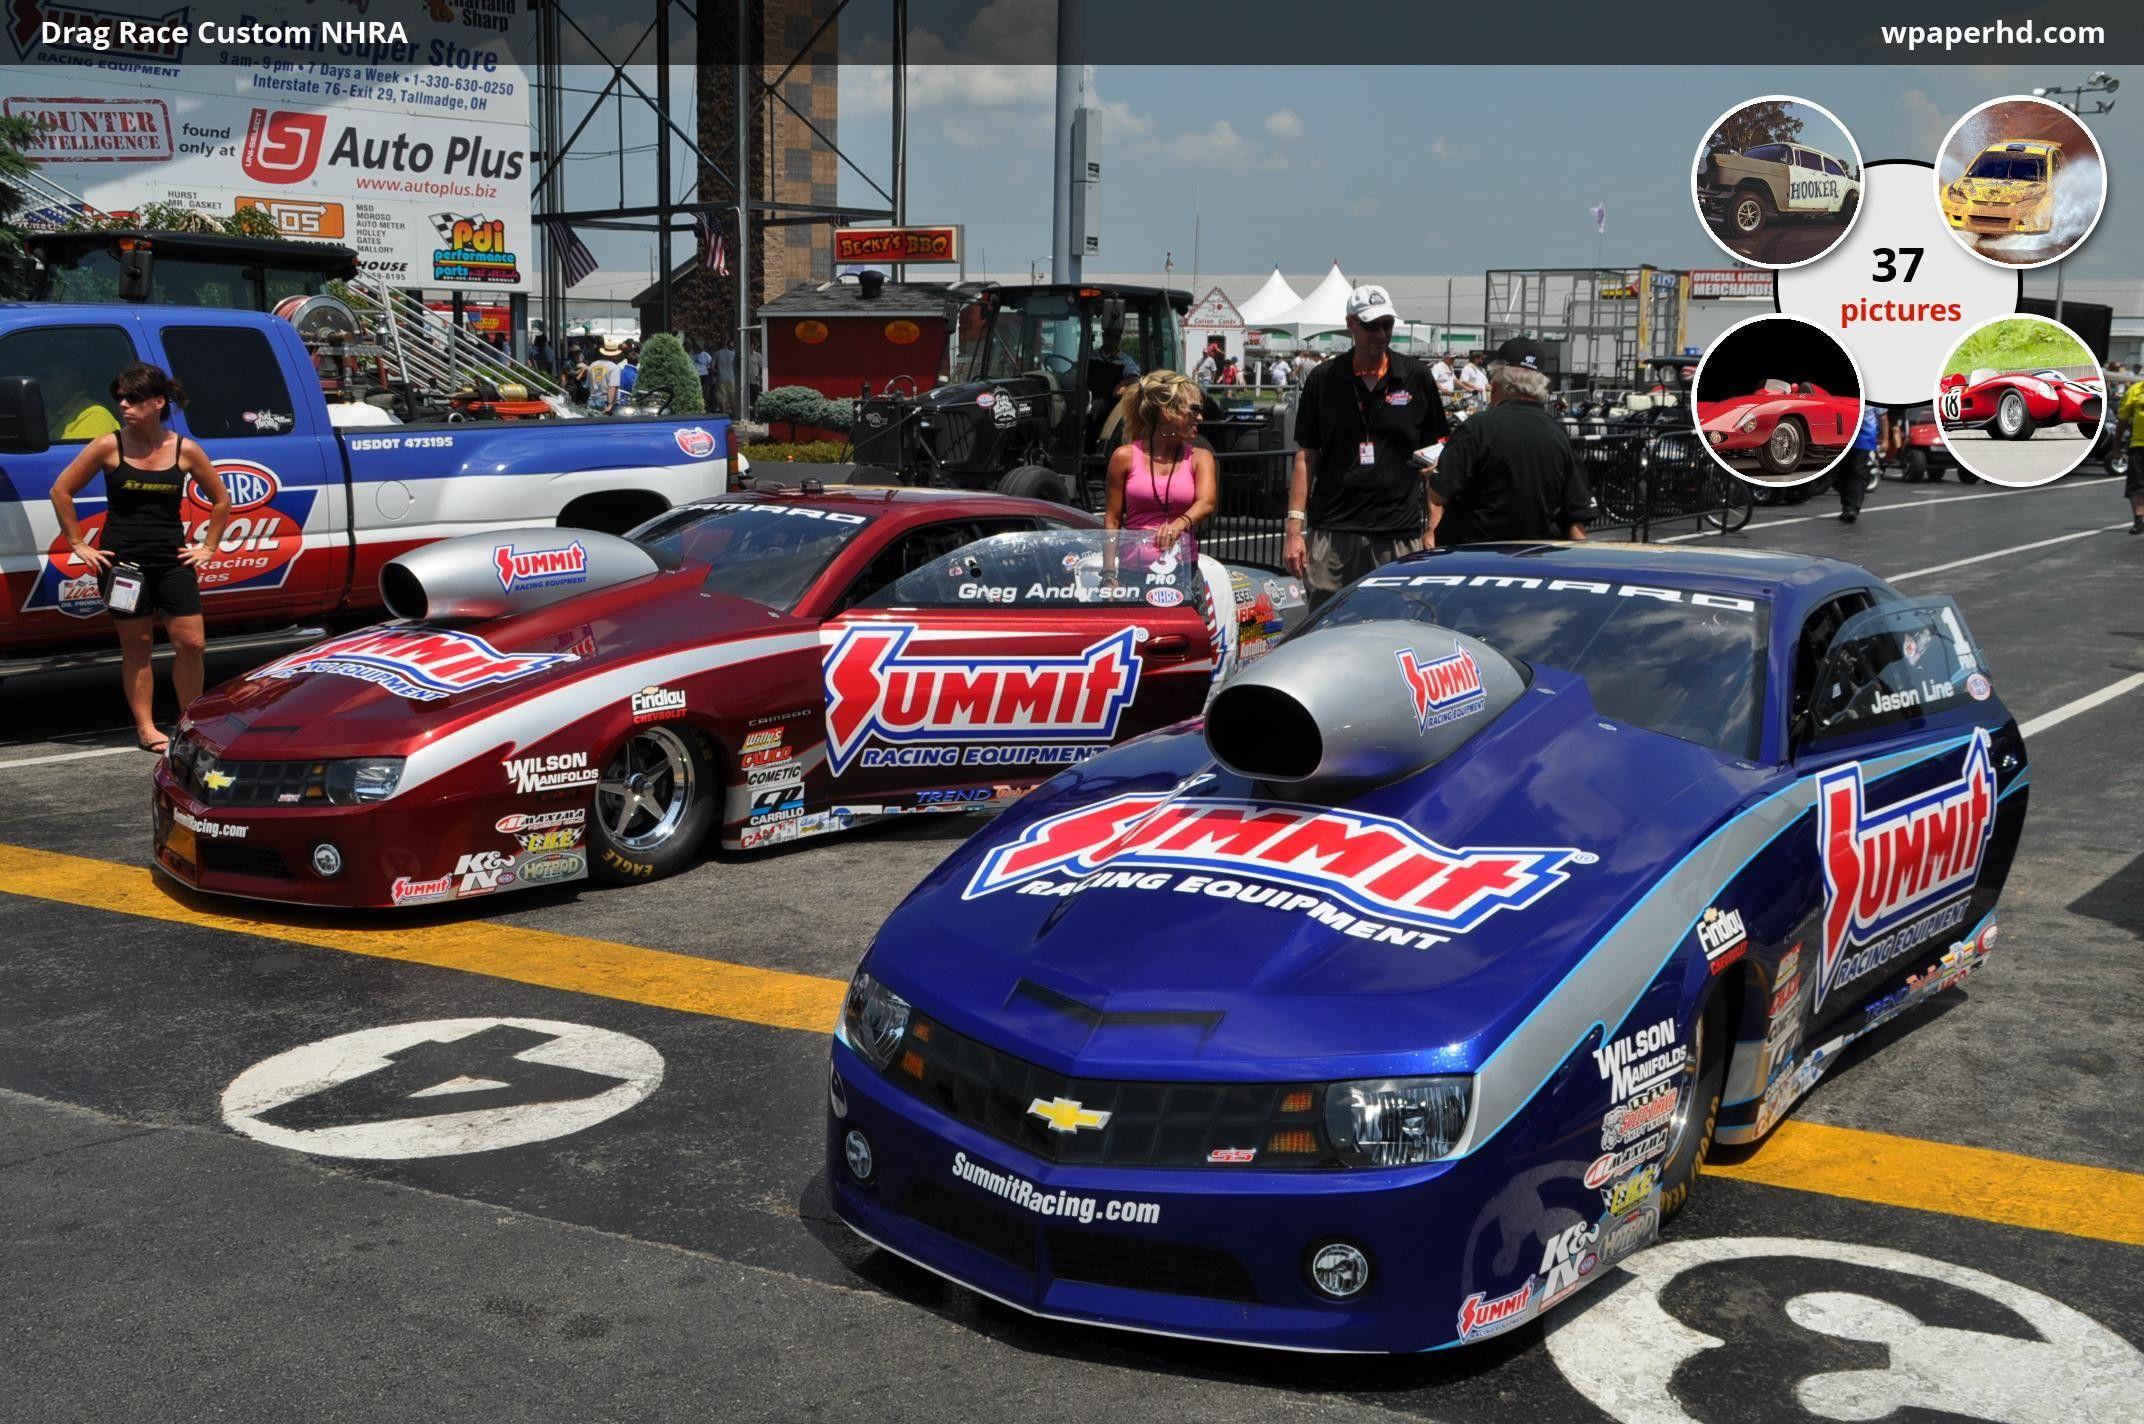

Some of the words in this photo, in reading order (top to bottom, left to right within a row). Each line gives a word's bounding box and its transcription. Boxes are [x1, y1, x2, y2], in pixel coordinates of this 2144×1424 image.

[462, 8, 510, 32] Sharp
[37, 51, 94, 68] RACING
[97, 60, 182, 78] EQUIPMENT
[428, 38, 498, 73] Store
[218, 52, 228, 65] 9
[274, 60, 294, 75] pm
[308, 61, 316, 75] 7
[320, 62, 351, 80] Days
[353, 69, 361, 80] a
[364, 67, 400, 85] Week
[413, 74, 514, 97] 1-330-630-0250
[253, 73, 320, 95] Interstate
[377, 86, 397, 104] 29,
[400, 89, 468, 111] Tallmadge,
[470, 97, 487, 111] OH
[182, 122, 231, 140] found
[245, 111, 263, 168] UNI-SELECT
[179, 141, 214, 158] only
[219, 145, 236, 157] at
[328, 126, 434, 173] Auto
[443, 135, 525, 180] Plus
[167, 191, 198, 199] HURST
[356, 176, 498, 199] www.autoplus.biz
[188, 200, 223, 210] GASKET
[356, 204, 375, 212] MSD
[356, 212, 392, 221] MOROSO
[356, 220, 376, 229] AUTO
[379, 221, 406, 230] METER
[356, 229, 386, 238] HOLLEY
[356, 237, 382, 245] GATES
[357, 245, 394, 254] MALLORY
[841, 233, 901, 257] BECKY'S
[905, 234, 948, 256] BBQ
[434, 250, 515, 263] performance
[435, 265, 469, 278] parts
[1693, 272, 1736, 282] OFFICIAL
[351, 438, 400, 451] USDOT
[404, 437, 454, 449] 473195
[216, 473, 265, 504] HRA
[672, 503, 867, 525] CAMARO
[514, 581, 544, 592] RACING
[545, 576, 587, 588] EQUIPMENT
[1145, 573, 1176, 585] PRO
[958, 582, 1017, 603] Greg
[1025, 582, 1140, 600] Anderson
[1151, 590, 1178, 604] NHRA
[1358, 575, 1756, 612] CAMARO
[1940, 606, 1973, 656] 1
[334, 662, 450, 702] EQUIPMENT
[1398, 645, 1481, 727] SUMMIT
[631, 689, 687, 712] Findlay
[827, 630, 1132, 760] SUMMIT
[1870, 690, 1920, 714] Jason
[1921, 679, 1955, 703] Line
[633, 708, 688, 724] CHEVROLET
[1428, 711, 1452, 729] RACING
[1453, 698, 1485, 719] EQUIPMENT
[502, 752, 587, 779] WILSON
[861, 747, 957, 768] RACING
[516, 768, 599, 794] MANIFOLDS
[748, 765, 801, 786] COMETIC
[916, 789, 992, 803] TREND
[750, 806, 805, 827] CARRILLO
[453, 850, 516, 893] K&N
[601, 848, 654, 877] EAGLE
[1821, 748, 1992, 990] SUMMIT
[393, 875, 451, 903] SUMMIT
[1016, 871, 1173, 898] RACING
[1178, 875, 1454, 951] EQUIPMENT
[1696, 908, 1748, 953] Findlay
[1834, 934, 1895, 989] RACING
[1890, 898, 1971, 958] EQUIPMENT
[1709, 940, 1749, 977] CHEVROLET
[1592, 1017, 1676, 1081] WILSON
[1610, 1044, 1688, 1105] MANIFOLDS
[1207, 1148, 1257, 1163] SS
[951, 1151, 1161, 1225] SummitRacing.com
[1539, 1220, 1600, 1301] K&N
[1459, 1280, 1533, 1338] SUMMIT
